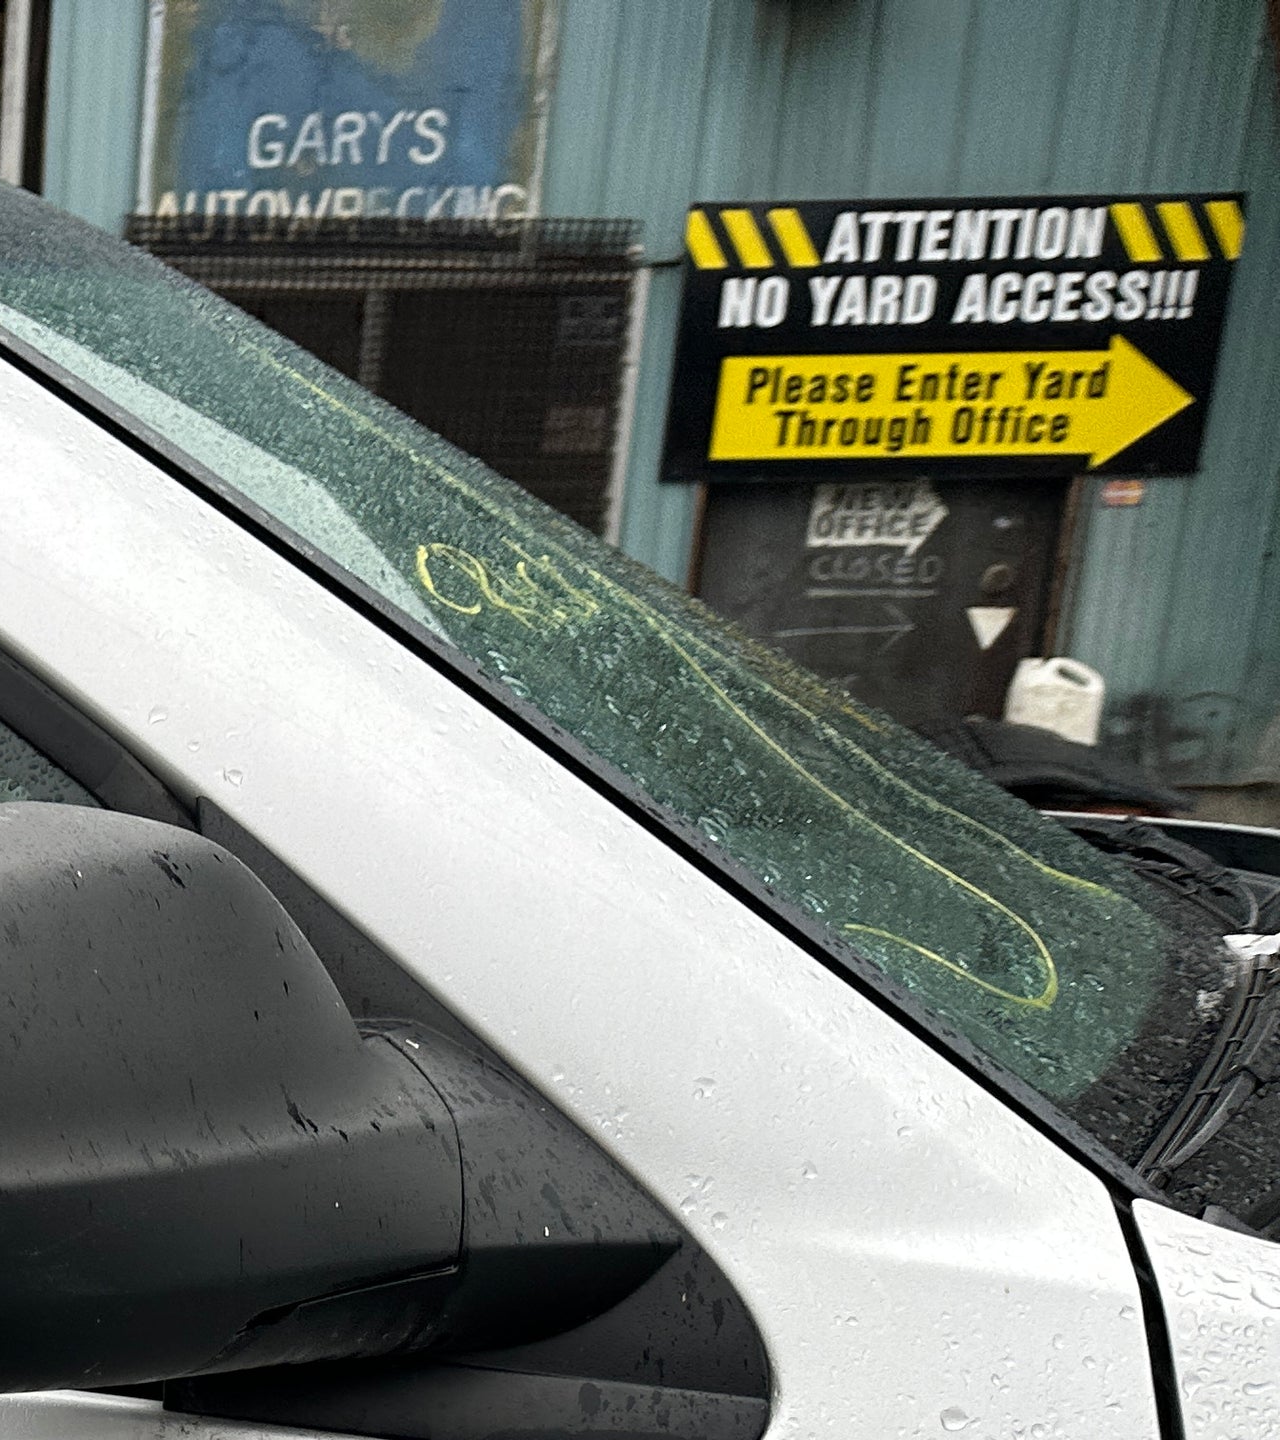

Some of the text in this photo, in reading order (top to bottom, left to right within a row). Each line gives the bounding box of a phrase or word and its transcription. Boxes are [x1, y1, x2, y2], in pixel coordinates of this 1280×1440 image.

[248, 108, 449, 169] GARY'S
[155, 184, 530, 239] AUTOWRECKING
[822, 206, 1109, 265] ATTENTION
[717, 269, 1200, 328] NO YARD ACCESS!!!
[746, 360, 1112, 405] Please Enter Yard
[776, 405, 1070, 453] Through Office
[814, 509, 932, 538] OFFICE
[809, 553, 943, 584] CLOSED
